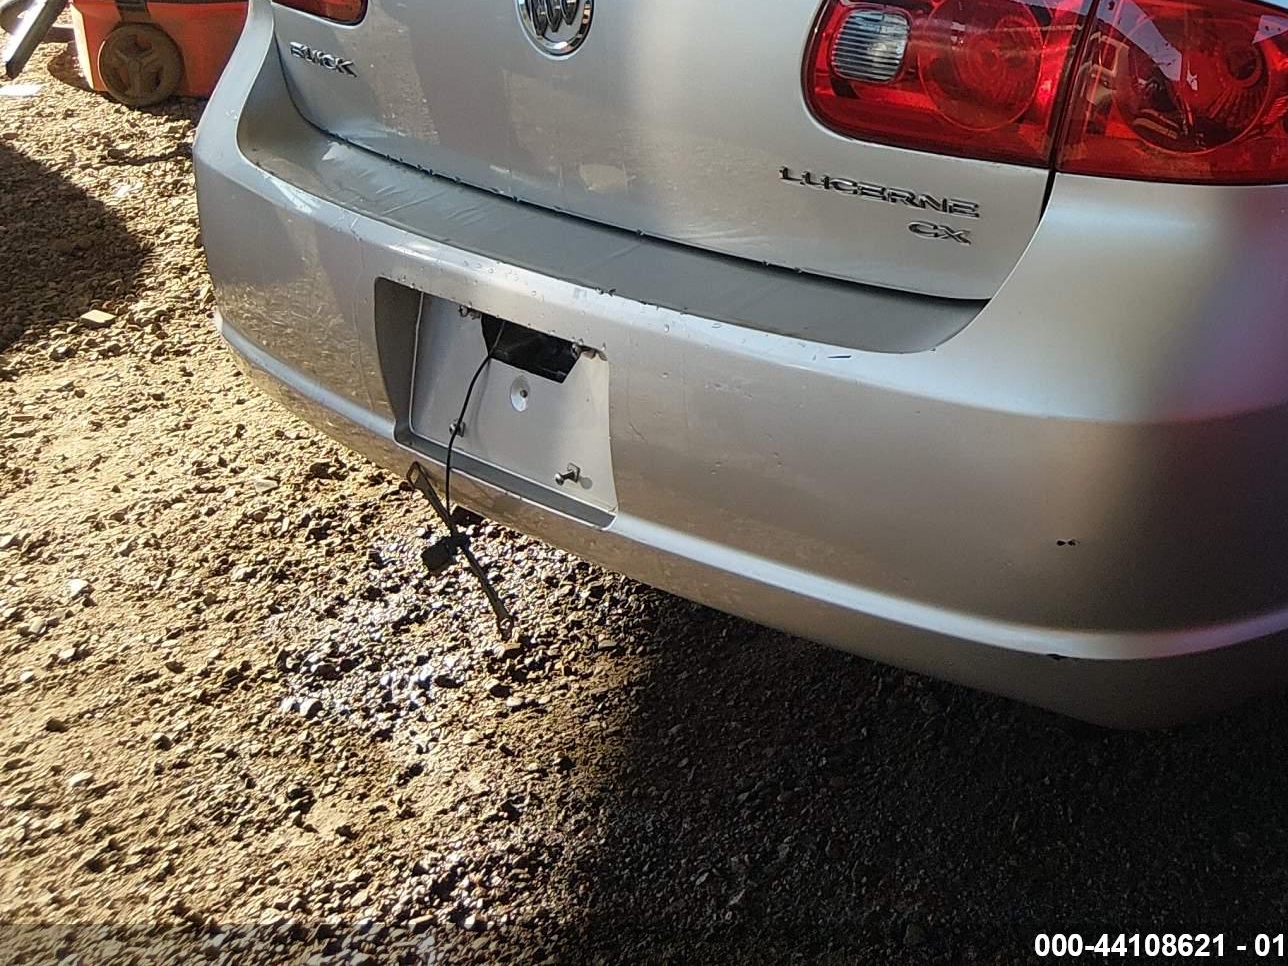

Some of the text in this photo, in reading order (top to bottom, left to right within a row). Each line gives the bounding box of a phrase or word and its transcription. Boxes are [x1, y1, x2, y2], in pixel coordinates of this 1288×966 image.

[289, 41, 358, 78] BUICK
[778, 165, 981, 219] LUCERNE
[906, 220, 972, 246] CX
